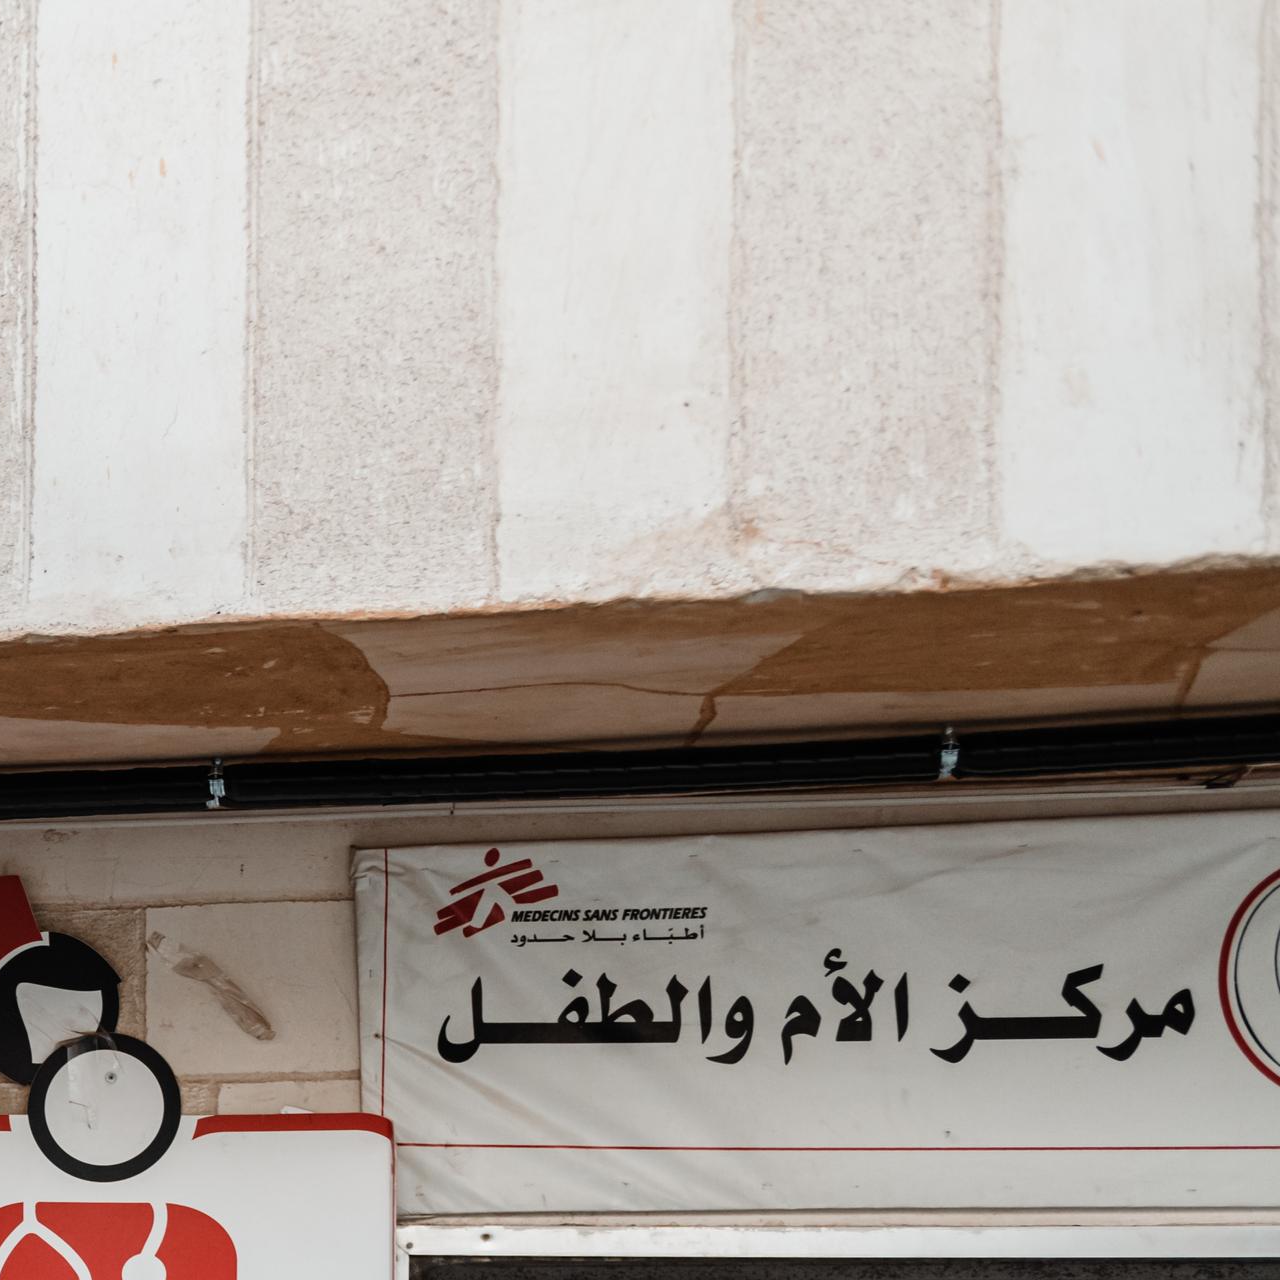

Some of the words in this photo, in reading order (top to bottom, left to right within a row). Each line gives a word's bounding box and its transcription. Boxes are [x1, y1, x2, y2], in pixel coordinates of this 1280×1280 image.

[510, 909, 582, 923] MEDECINS
[582, 908, 620, 922] SANS
[621, 906, 708, 921] FRONTIERES
[510, 933, 576, 948] حدود
[581, 929, 628, 946] بلا
[437, 968, 755, 1065] والطفل
[780, 947, 910, 1066] الأم
[929, 963, 1196, 1064] مركز
